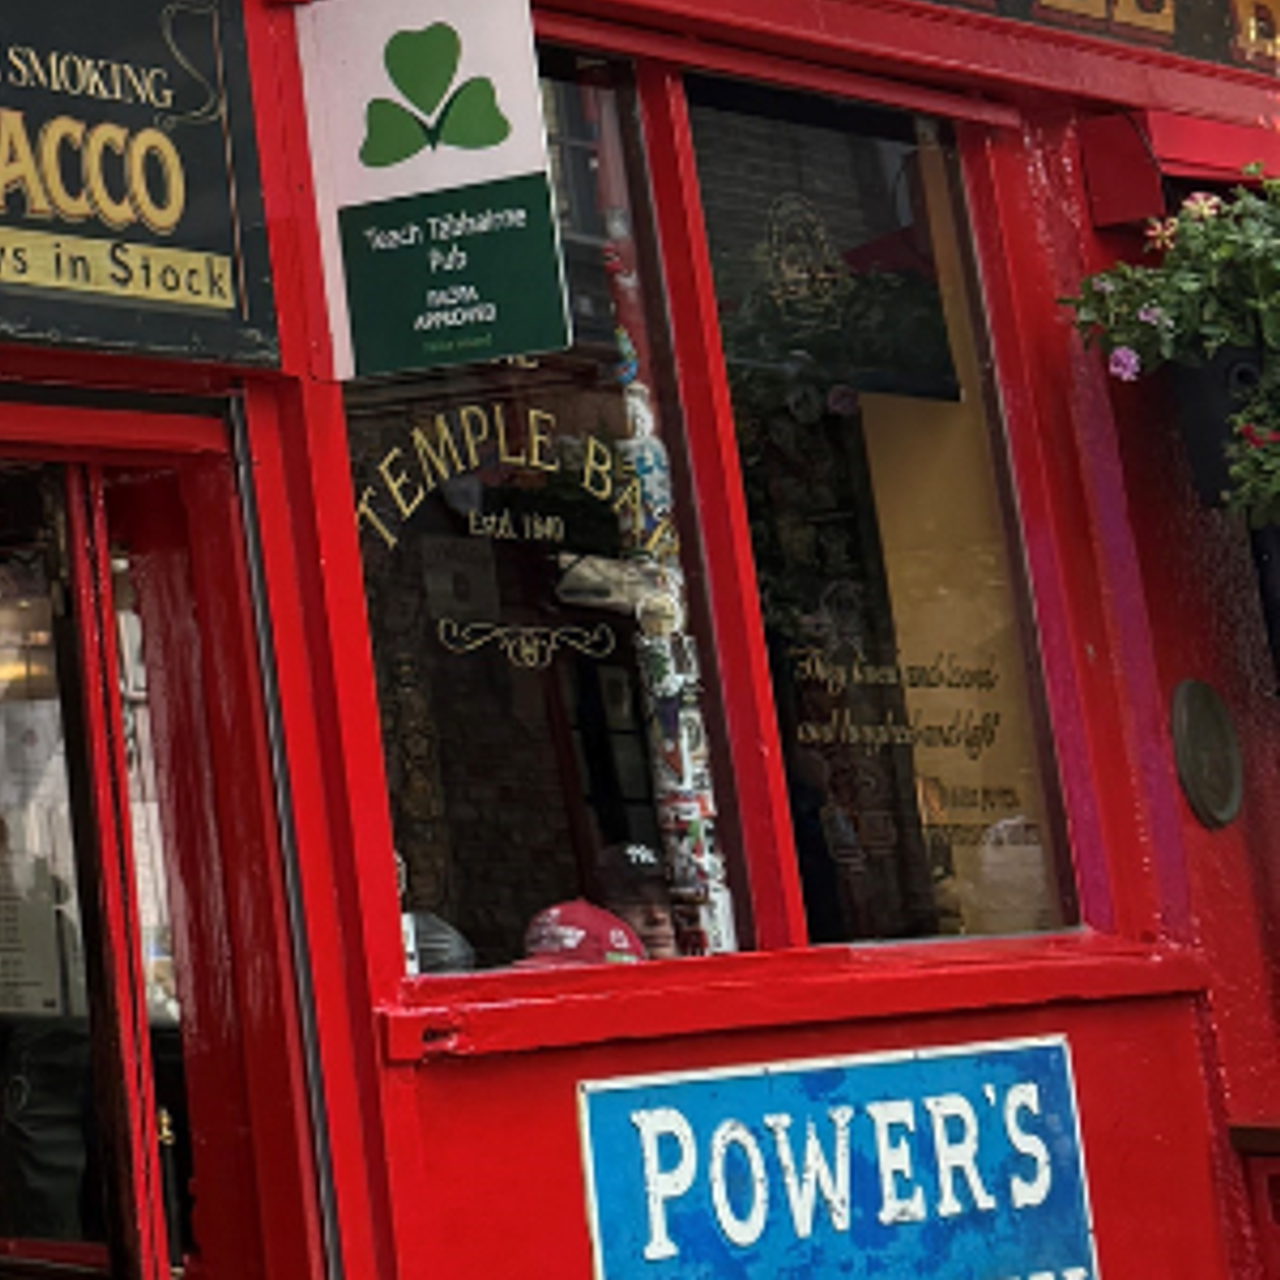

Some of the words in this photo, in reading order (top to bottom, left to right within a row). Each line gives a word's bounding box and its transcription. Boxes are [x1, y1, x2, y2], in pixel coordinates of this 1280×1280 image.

[7, 44, 175, 110] SMOKING
[53, 242, 92, 284] in
[108, 243, 230, 302] Stock
[427, 243, 468, 274] Pub
[356, 404, 561, 552] TEMPLE
[629, 1081, 1053, 1261] POWER'S
